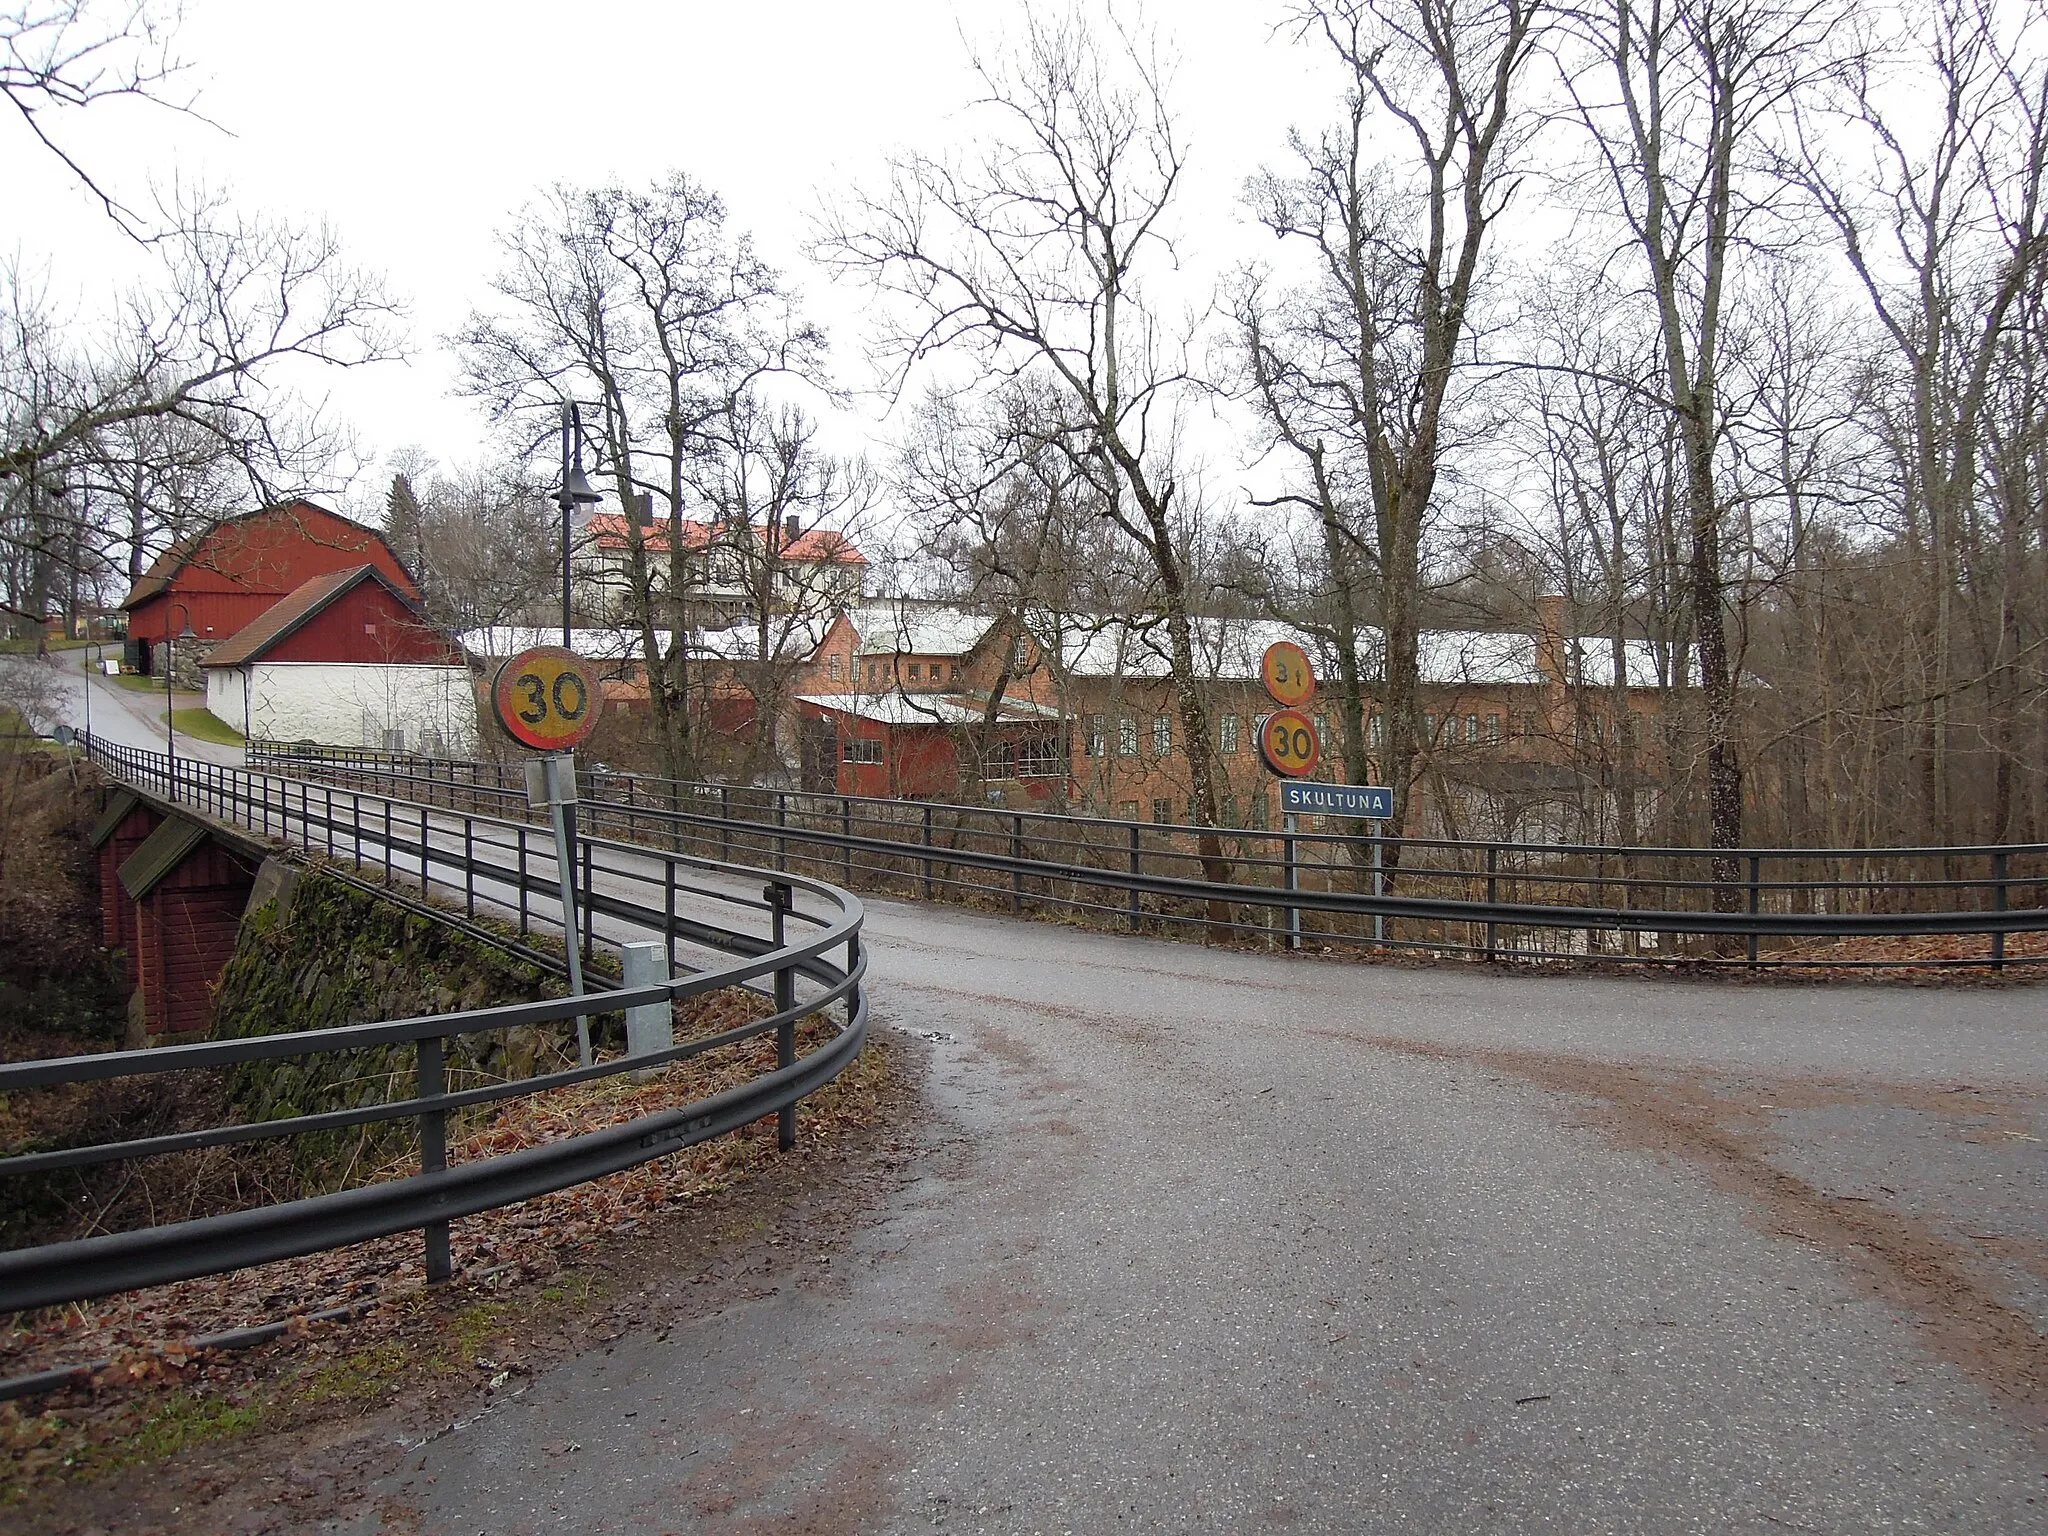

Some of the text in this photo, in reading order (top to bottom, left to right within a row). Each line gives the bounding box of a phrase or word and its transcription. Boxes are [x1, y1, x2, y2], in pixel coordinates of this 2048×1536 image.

[517, 671, 587, 724] 30
[1273, 725, 1312, 760] 30
[1290, 789, 1384, 810] SKULTUNA
